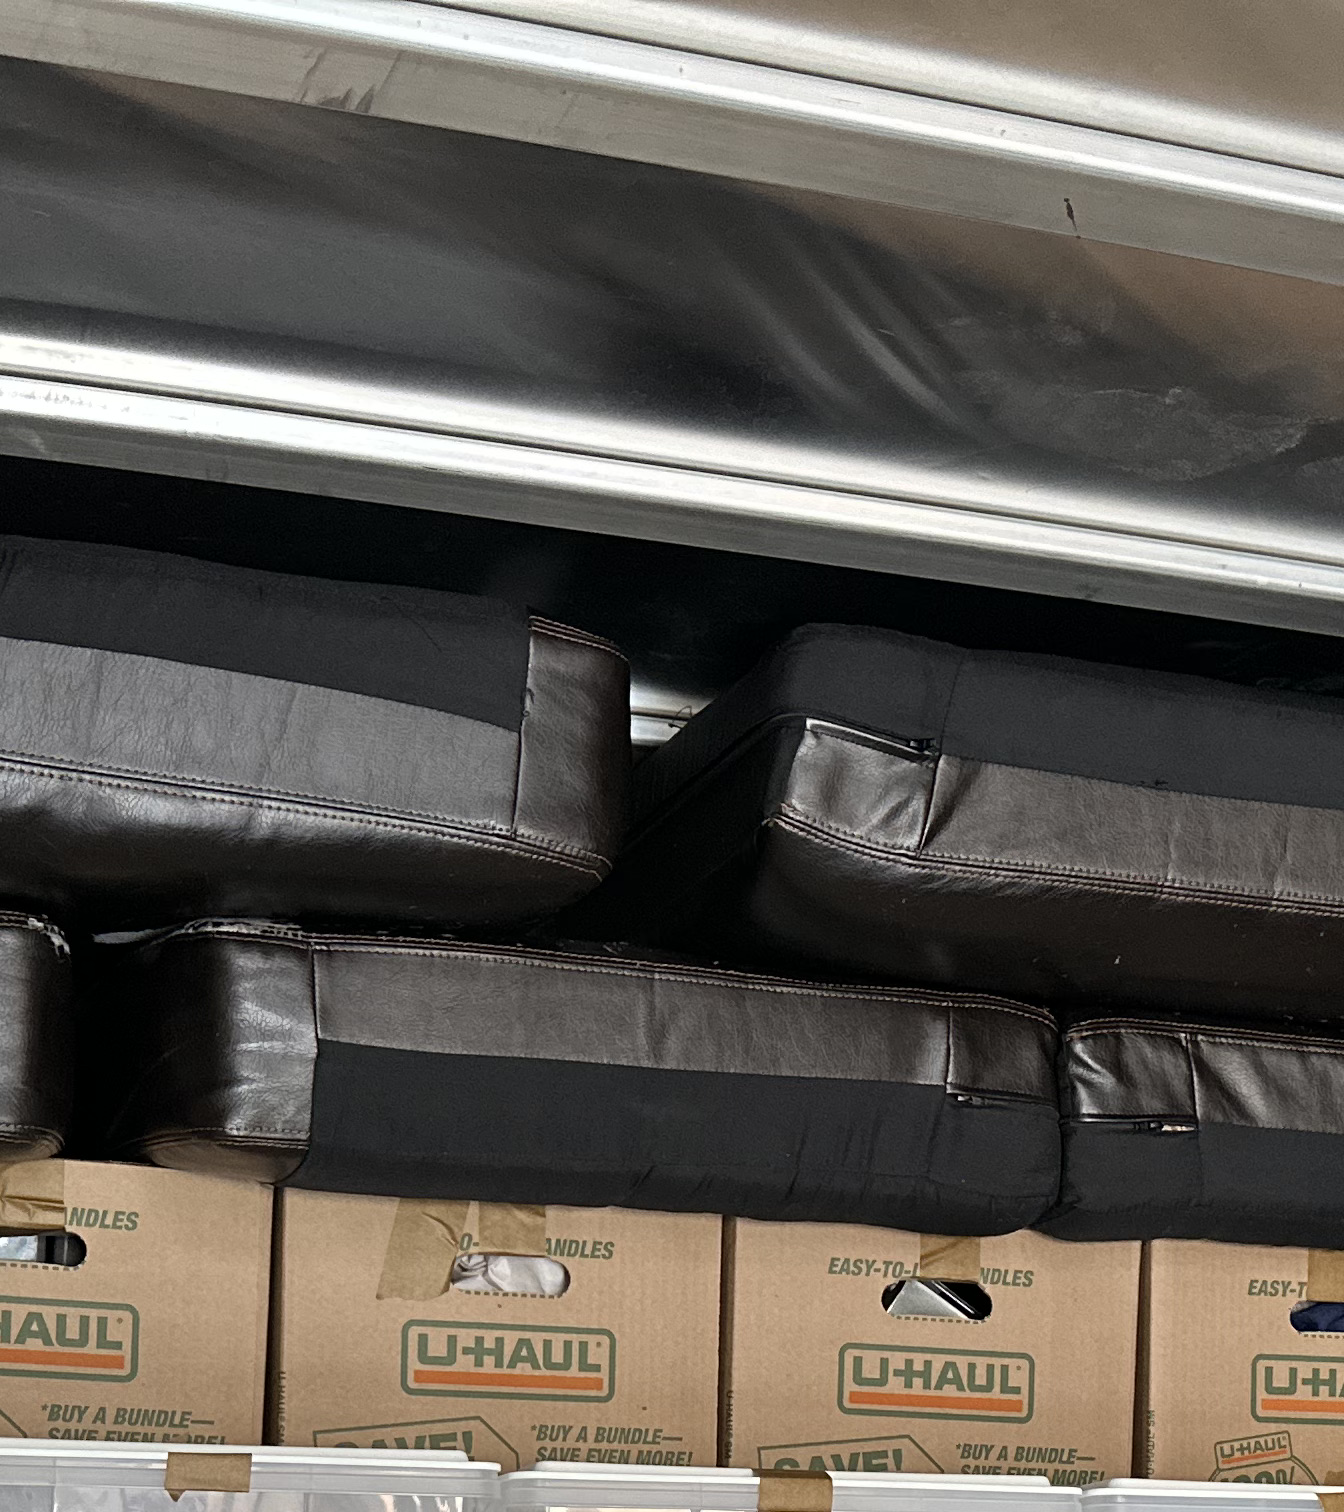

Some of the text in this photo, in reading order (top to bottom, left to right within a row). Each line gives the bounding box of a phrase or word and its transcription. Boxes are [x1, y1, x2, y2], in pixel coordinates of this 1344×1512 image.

[417, 1333, 602, 1373] U-HAUL
[852, 1355, 1022, 1395] U-HAUL
[92, 1406, 106, 1424] A
[575, 1426, 588, 1442] A
[536, 1446, 693, 1467] SAVE EVEN MORE!
[996, 1446, 1008, 1462] A
[1219, 1436, 1287, 1458] U-HAUL
